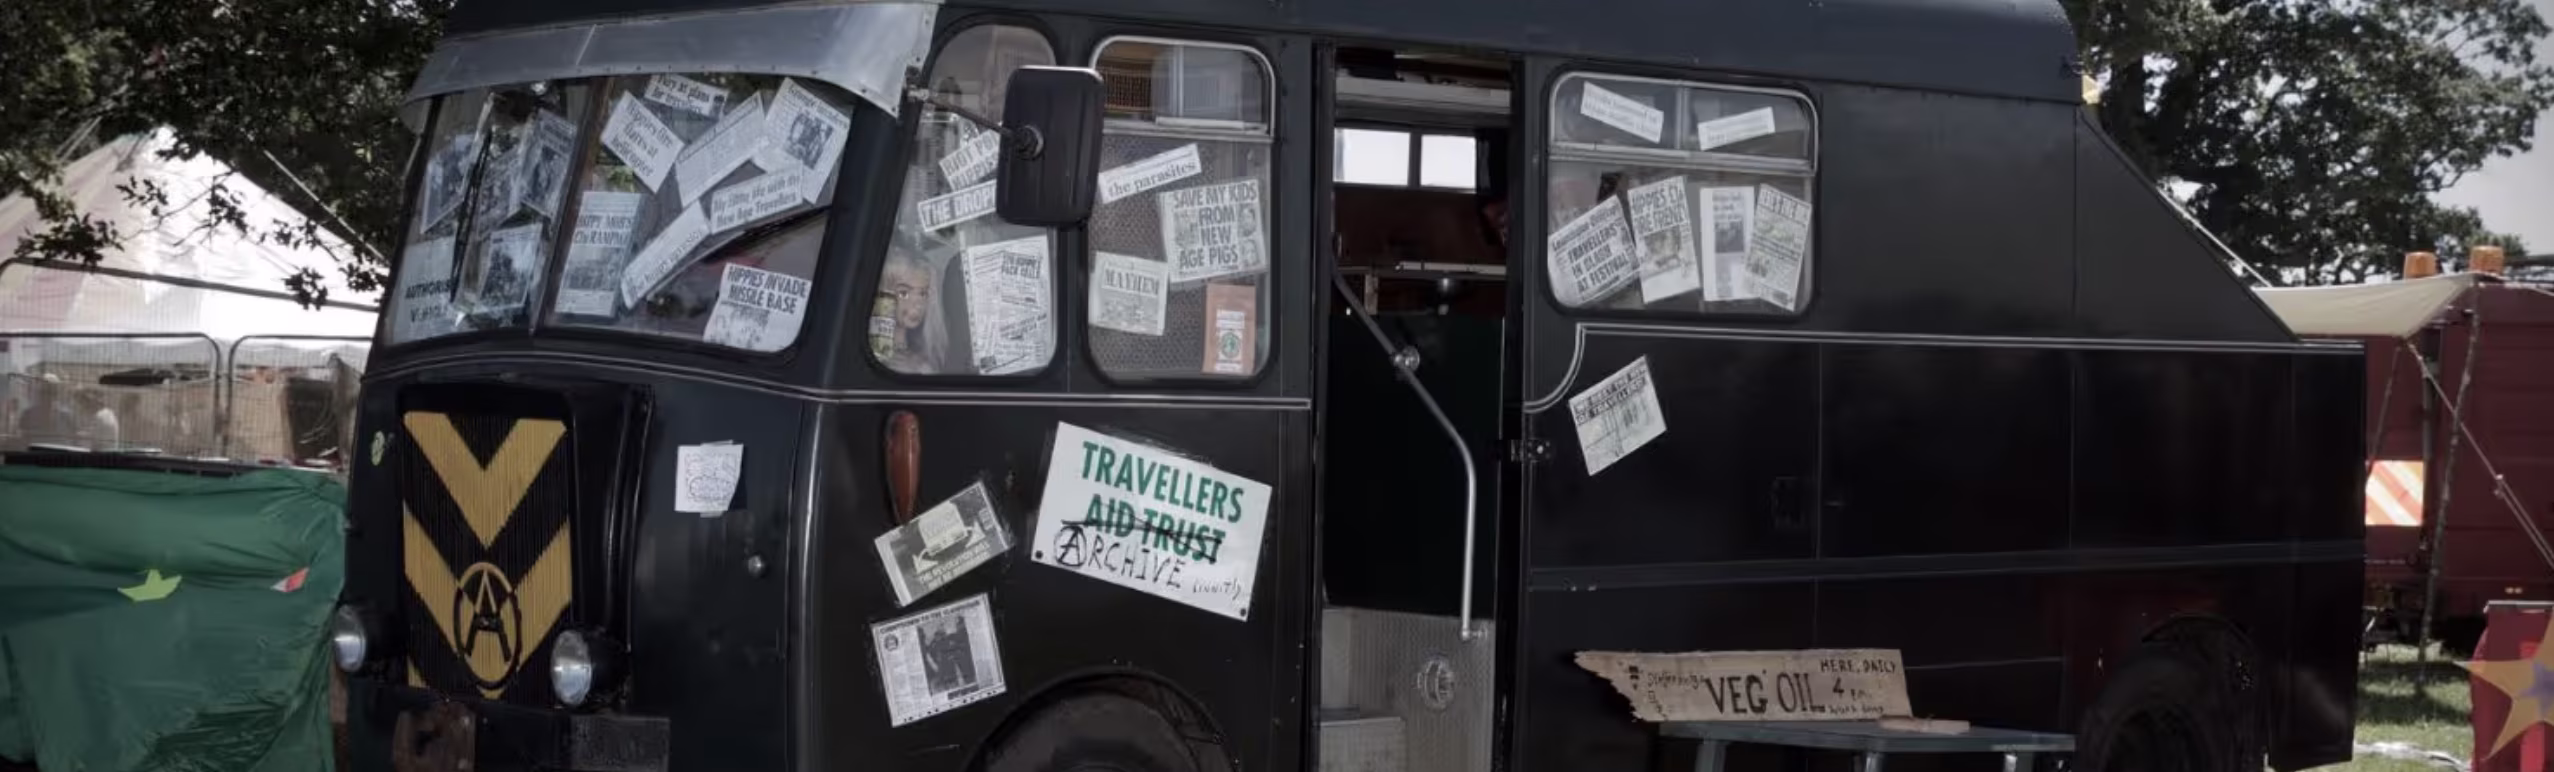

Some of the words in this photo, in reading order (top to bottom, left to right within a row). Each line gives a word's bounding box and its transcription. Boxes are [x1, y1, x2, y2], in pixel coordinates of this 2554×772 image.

[943, 143, 975, 174] RIOT
[1108, 181, 1130, 198] the
[1135, 161, 1197, 193] parasites
[1173, 190, 1203, 209] SAVE
[1205, 187, 1226, 205] MY
[1228, 184, 1257, 201] KIDS
[922, 202, 951, 227] THE
[1199, 205, 1234, 224] FROM
[1201, 226, 1232, 247] NEW
[1567, 224, 1618, 263] TRAVELLERS
[1179, 250, 1204, 270] AGE
[1209, 246, 1239, 266] PIGS
[1577, 275, 1591, 291] AT
[1591, 253, 1631, 285] FESTIVAL
[405, 278, 451, 299] AUTHORIS
[727, 266, 765, 289] HIPPIES
[764, 271, 807, 298] INVADE
[1103, 269, 1160, 296] MAYHEM
[729, 284, 766, 307] MISSILE
[767, 291, 798, 315] BASE
[1081, 440, 1244, 524] TRAVELLERS
[1084, 493, 1136, 538] AID
[1141, 508, 1226, 561] TRUST
[1054, 525, 1186, 588] ARCHIVE
[1863, 659, 1896, 674] DAILY
[1777, 672, 1826, 714] OIL
[1832, 676, 1845, 698] 4
